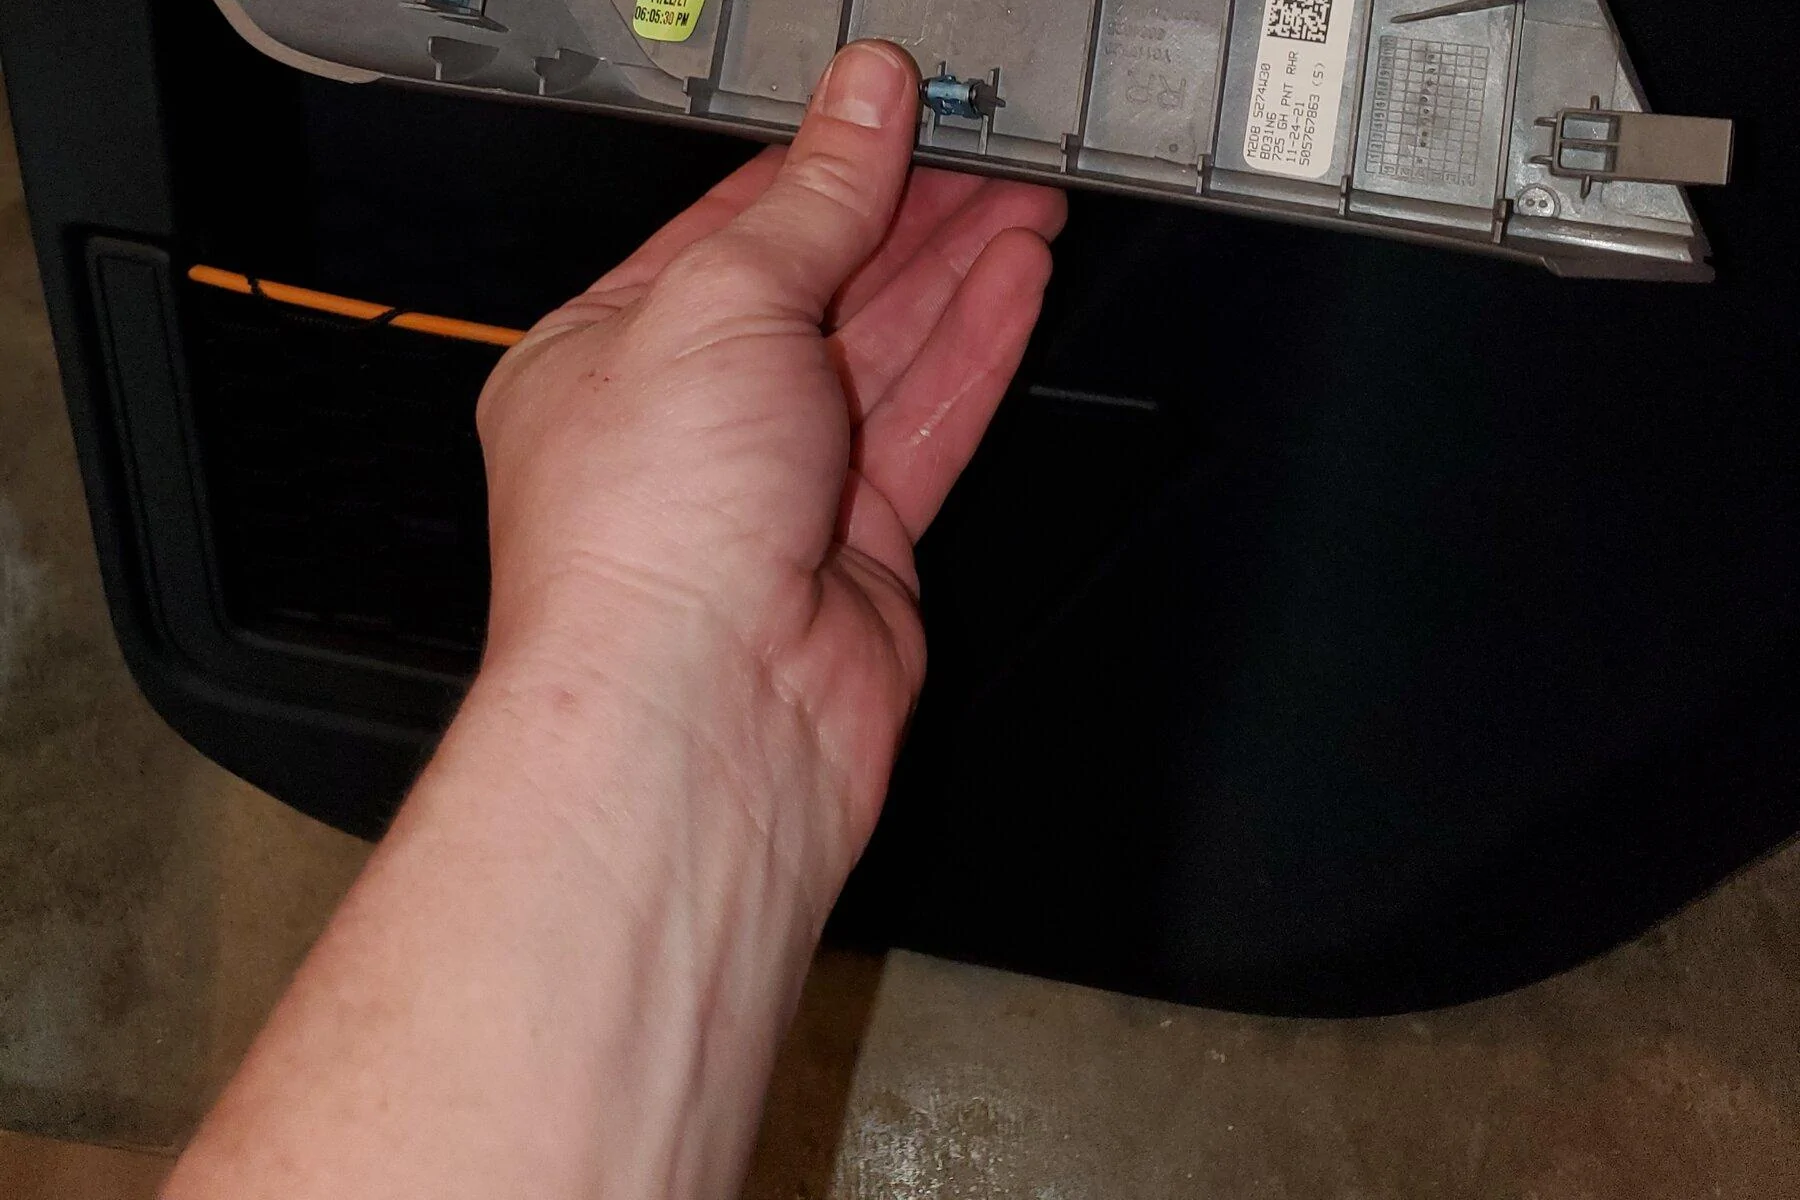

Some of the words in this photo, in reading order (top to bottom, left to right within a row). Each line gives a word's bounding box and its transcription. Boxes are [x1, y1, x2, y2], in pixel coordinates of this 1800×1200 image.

[634, 5, 675, 26] 06:05:30
[675, 12, 690, 26] PM
[1286, 51, 1298, 75] RHR
[1281, 82, 1293, 106] PNT
[1276, 114, 1288, 129] GH
[1286, 102, 1304, 163] 11-24-21
[1299, 95, 1320, 166] 505767863
